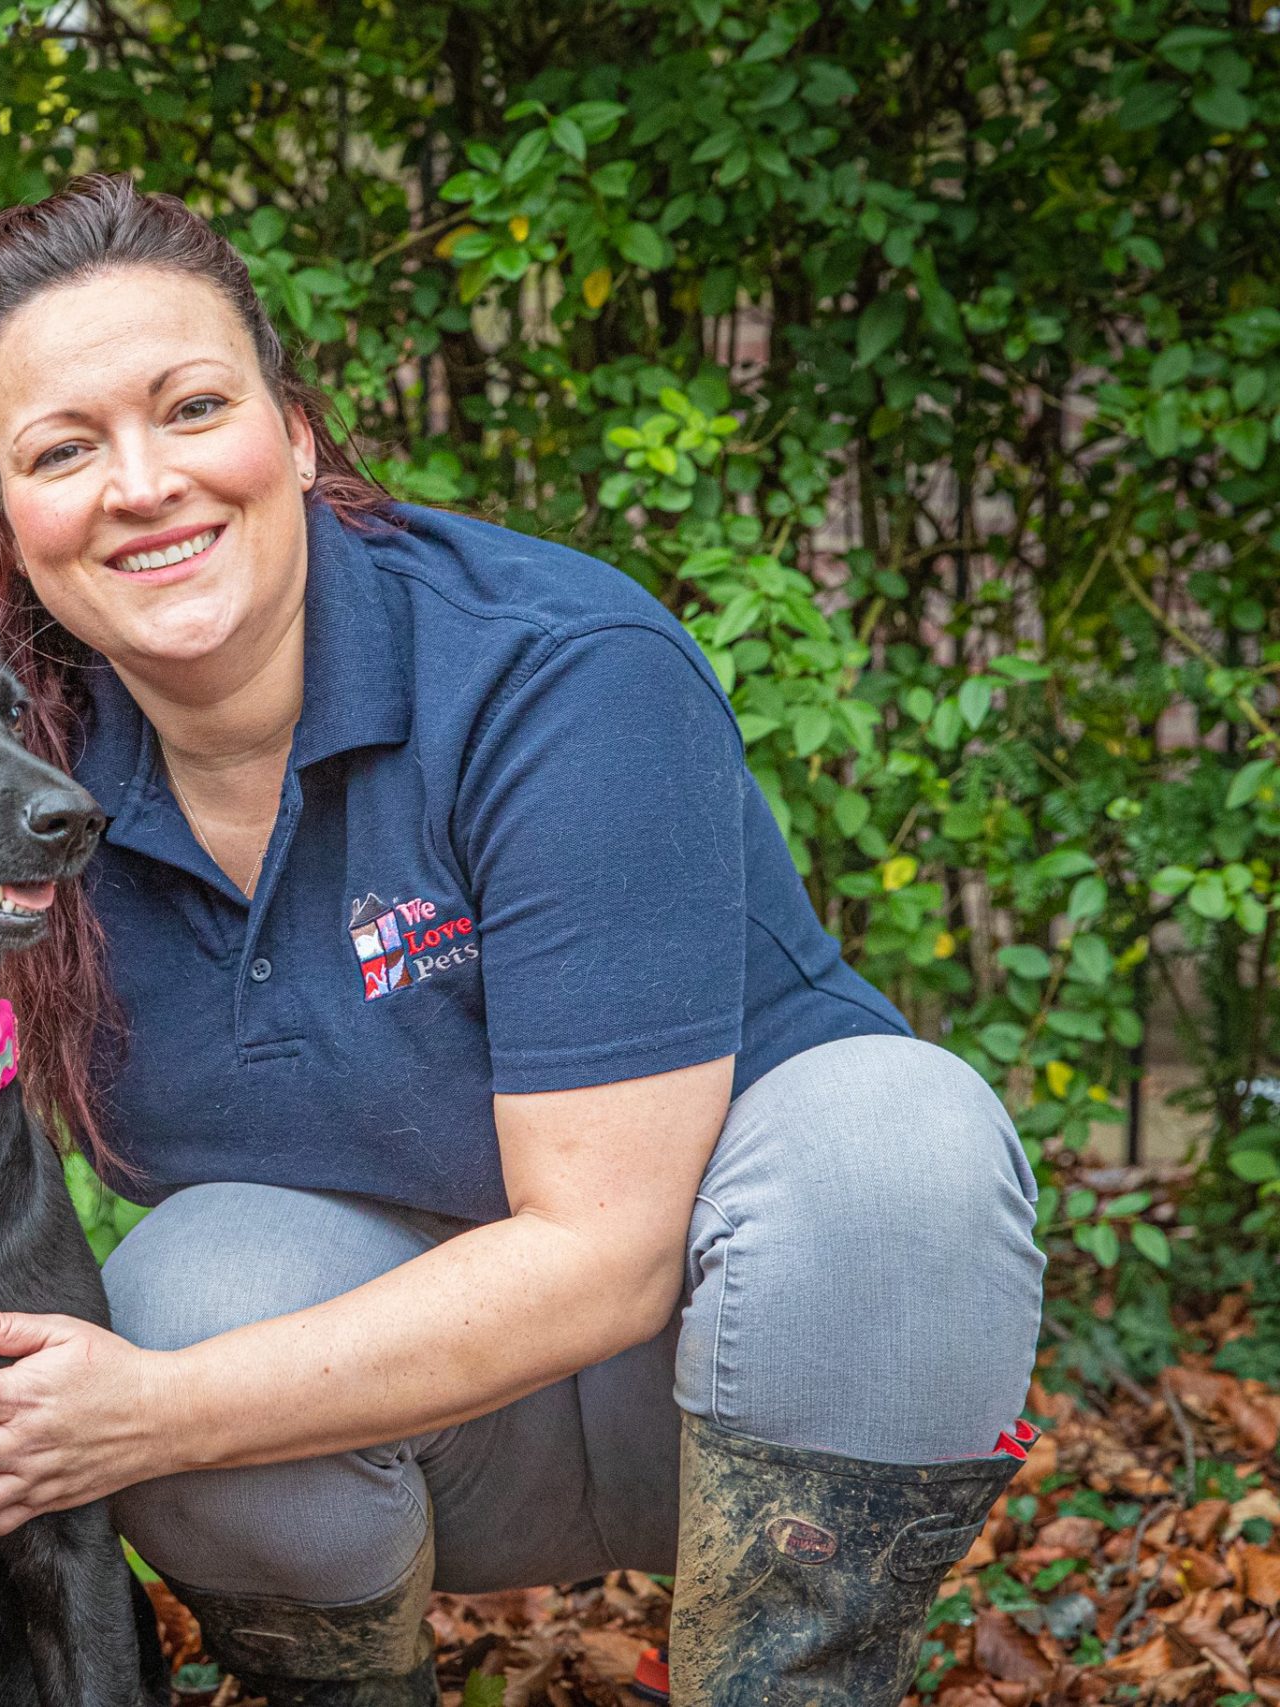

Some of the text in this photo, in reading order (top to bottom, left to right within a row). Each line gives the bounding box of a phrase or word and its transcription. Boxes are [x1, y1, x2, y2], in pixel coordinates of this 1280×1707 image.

[396, 898, 436, 926] We
[402, 917, 473, 956] Love
[412, 942, 479, 981] Pets
